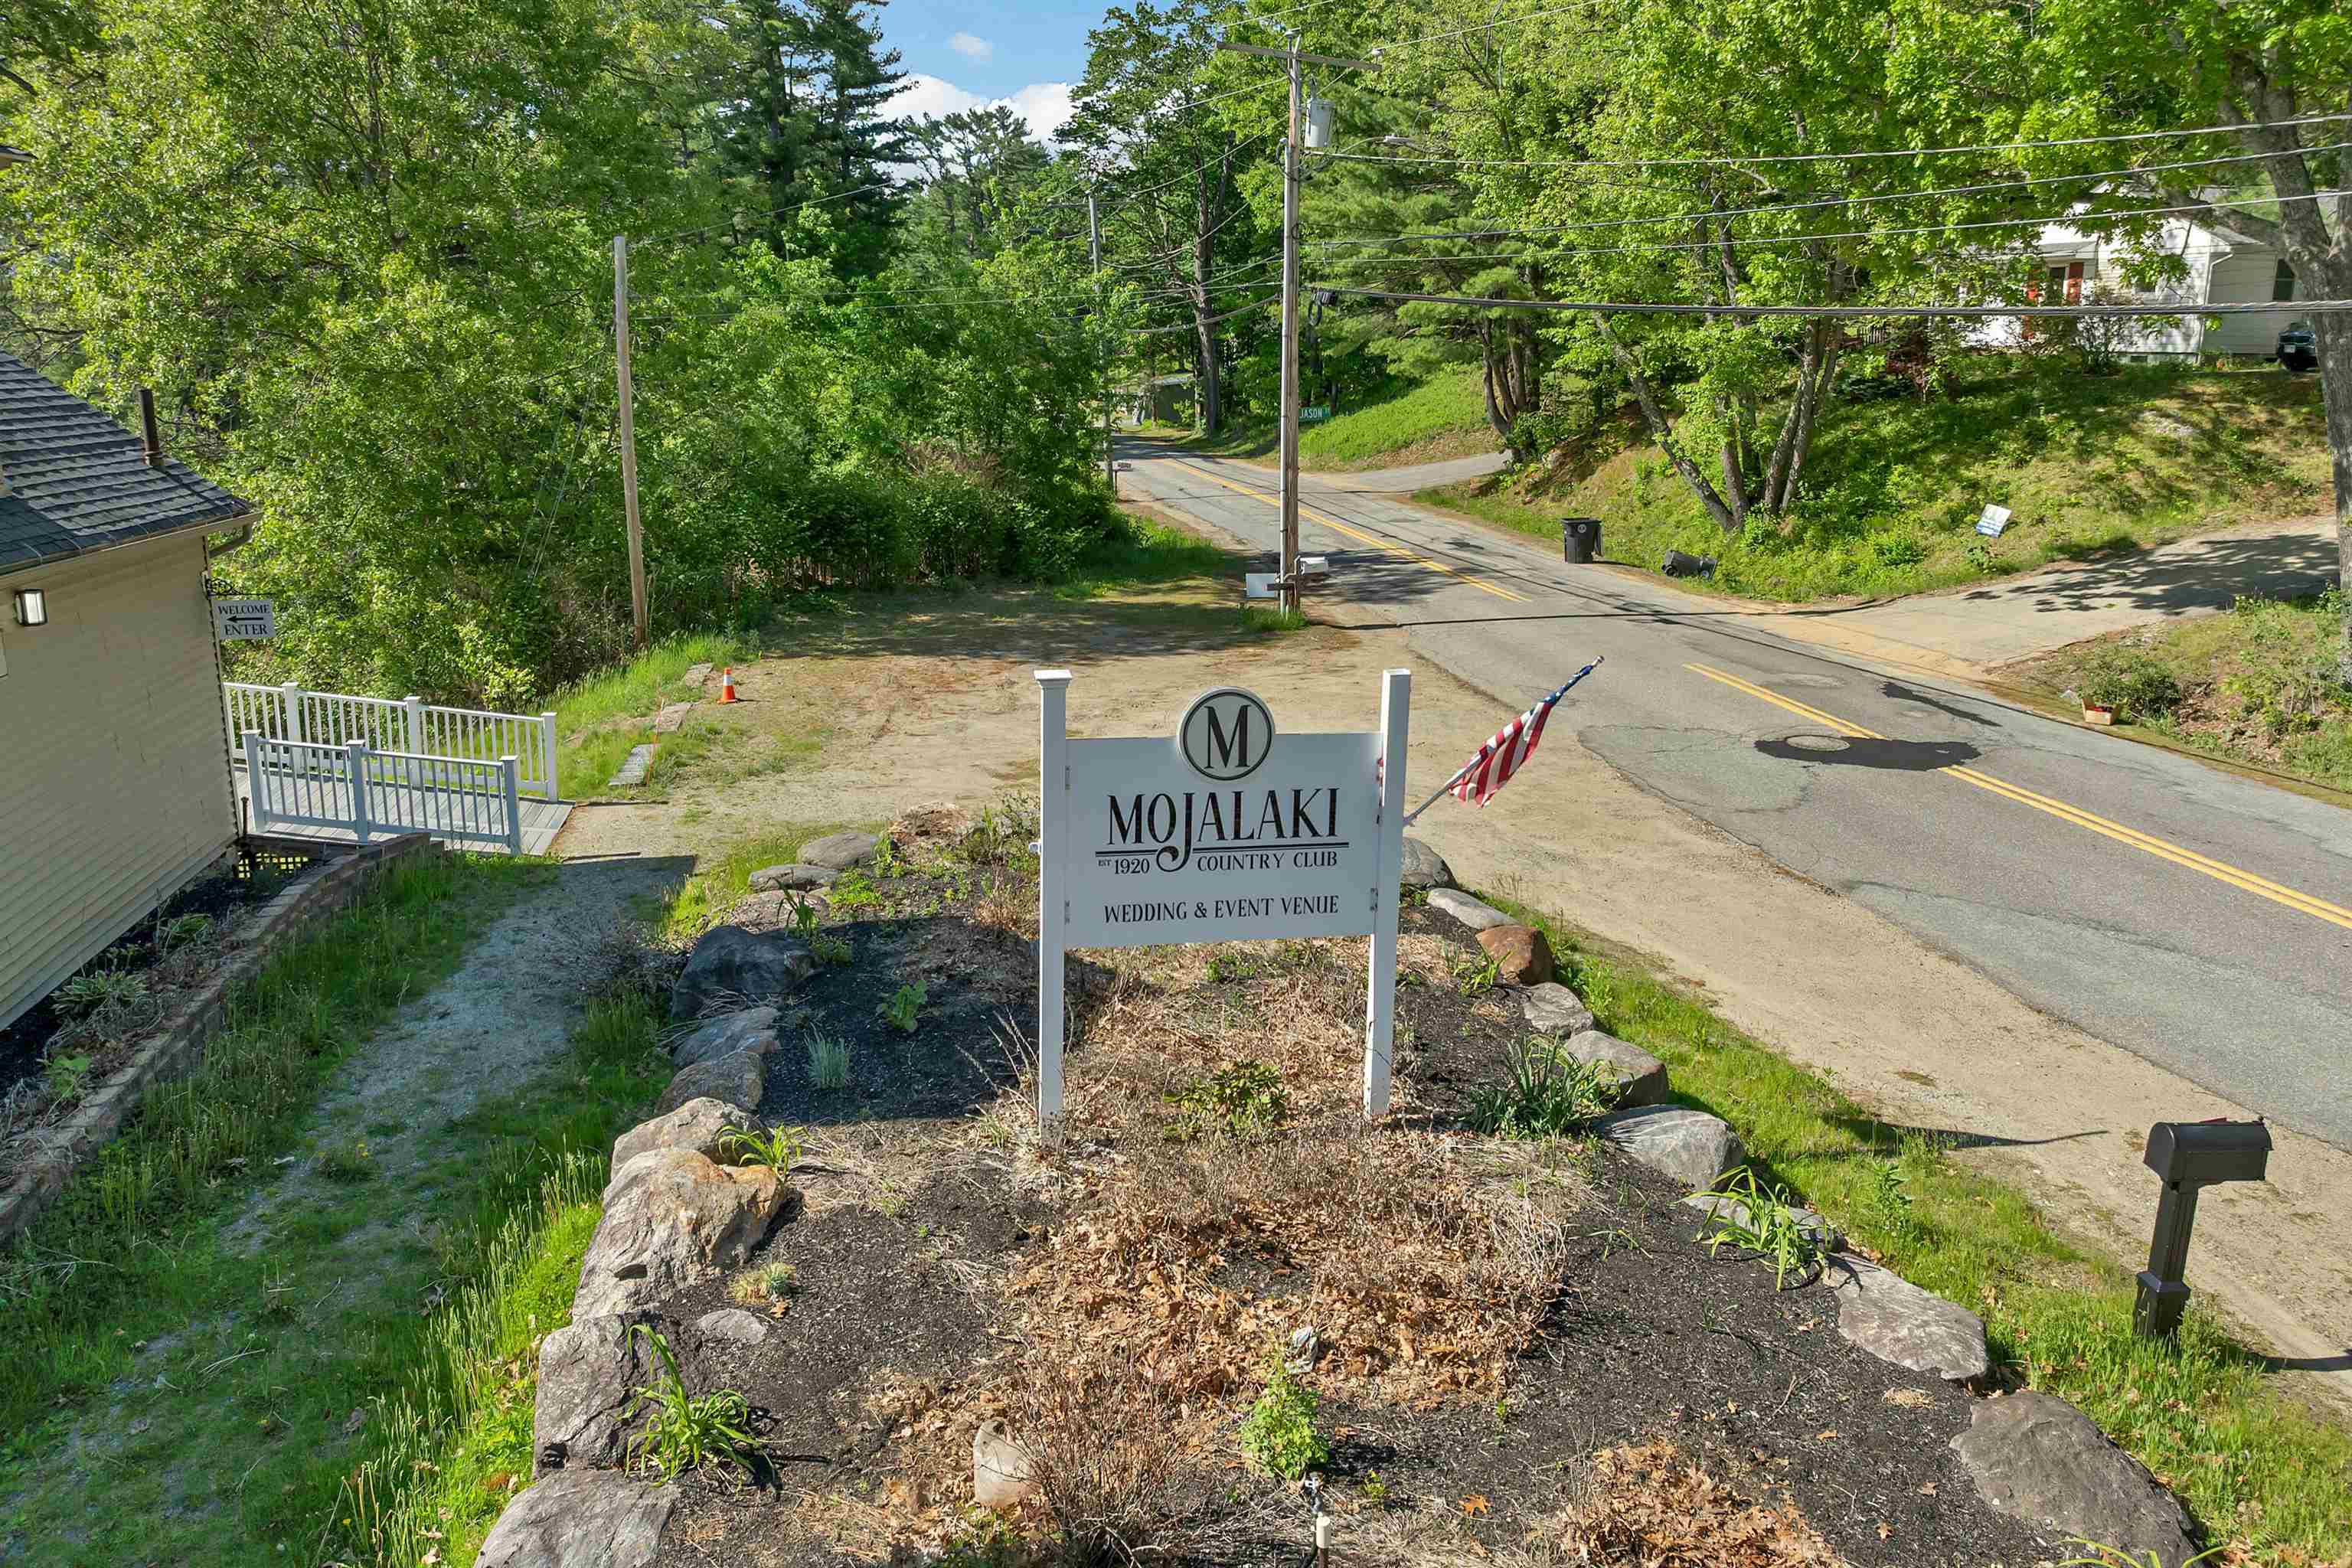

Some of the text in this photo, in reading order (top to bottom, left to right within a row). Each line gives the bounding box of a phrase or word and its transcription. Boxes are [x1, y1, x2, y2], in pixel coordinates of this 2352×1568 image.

[1300, 408, 1323, 418] JASON
[218, 604, 270, 614] WELCOME
[225, 624, 268, 635] ENTER
[1204, 704, 1252, 769] M
[1107, 788, 1341, 873] MOJALAKI
[1114, 858, 1151, 874] 1920
[1197, 851, 1338, 871] COUNTRY CLUB
[1104, 896, 1339, 923] WEDDING & EVENT VENUE
